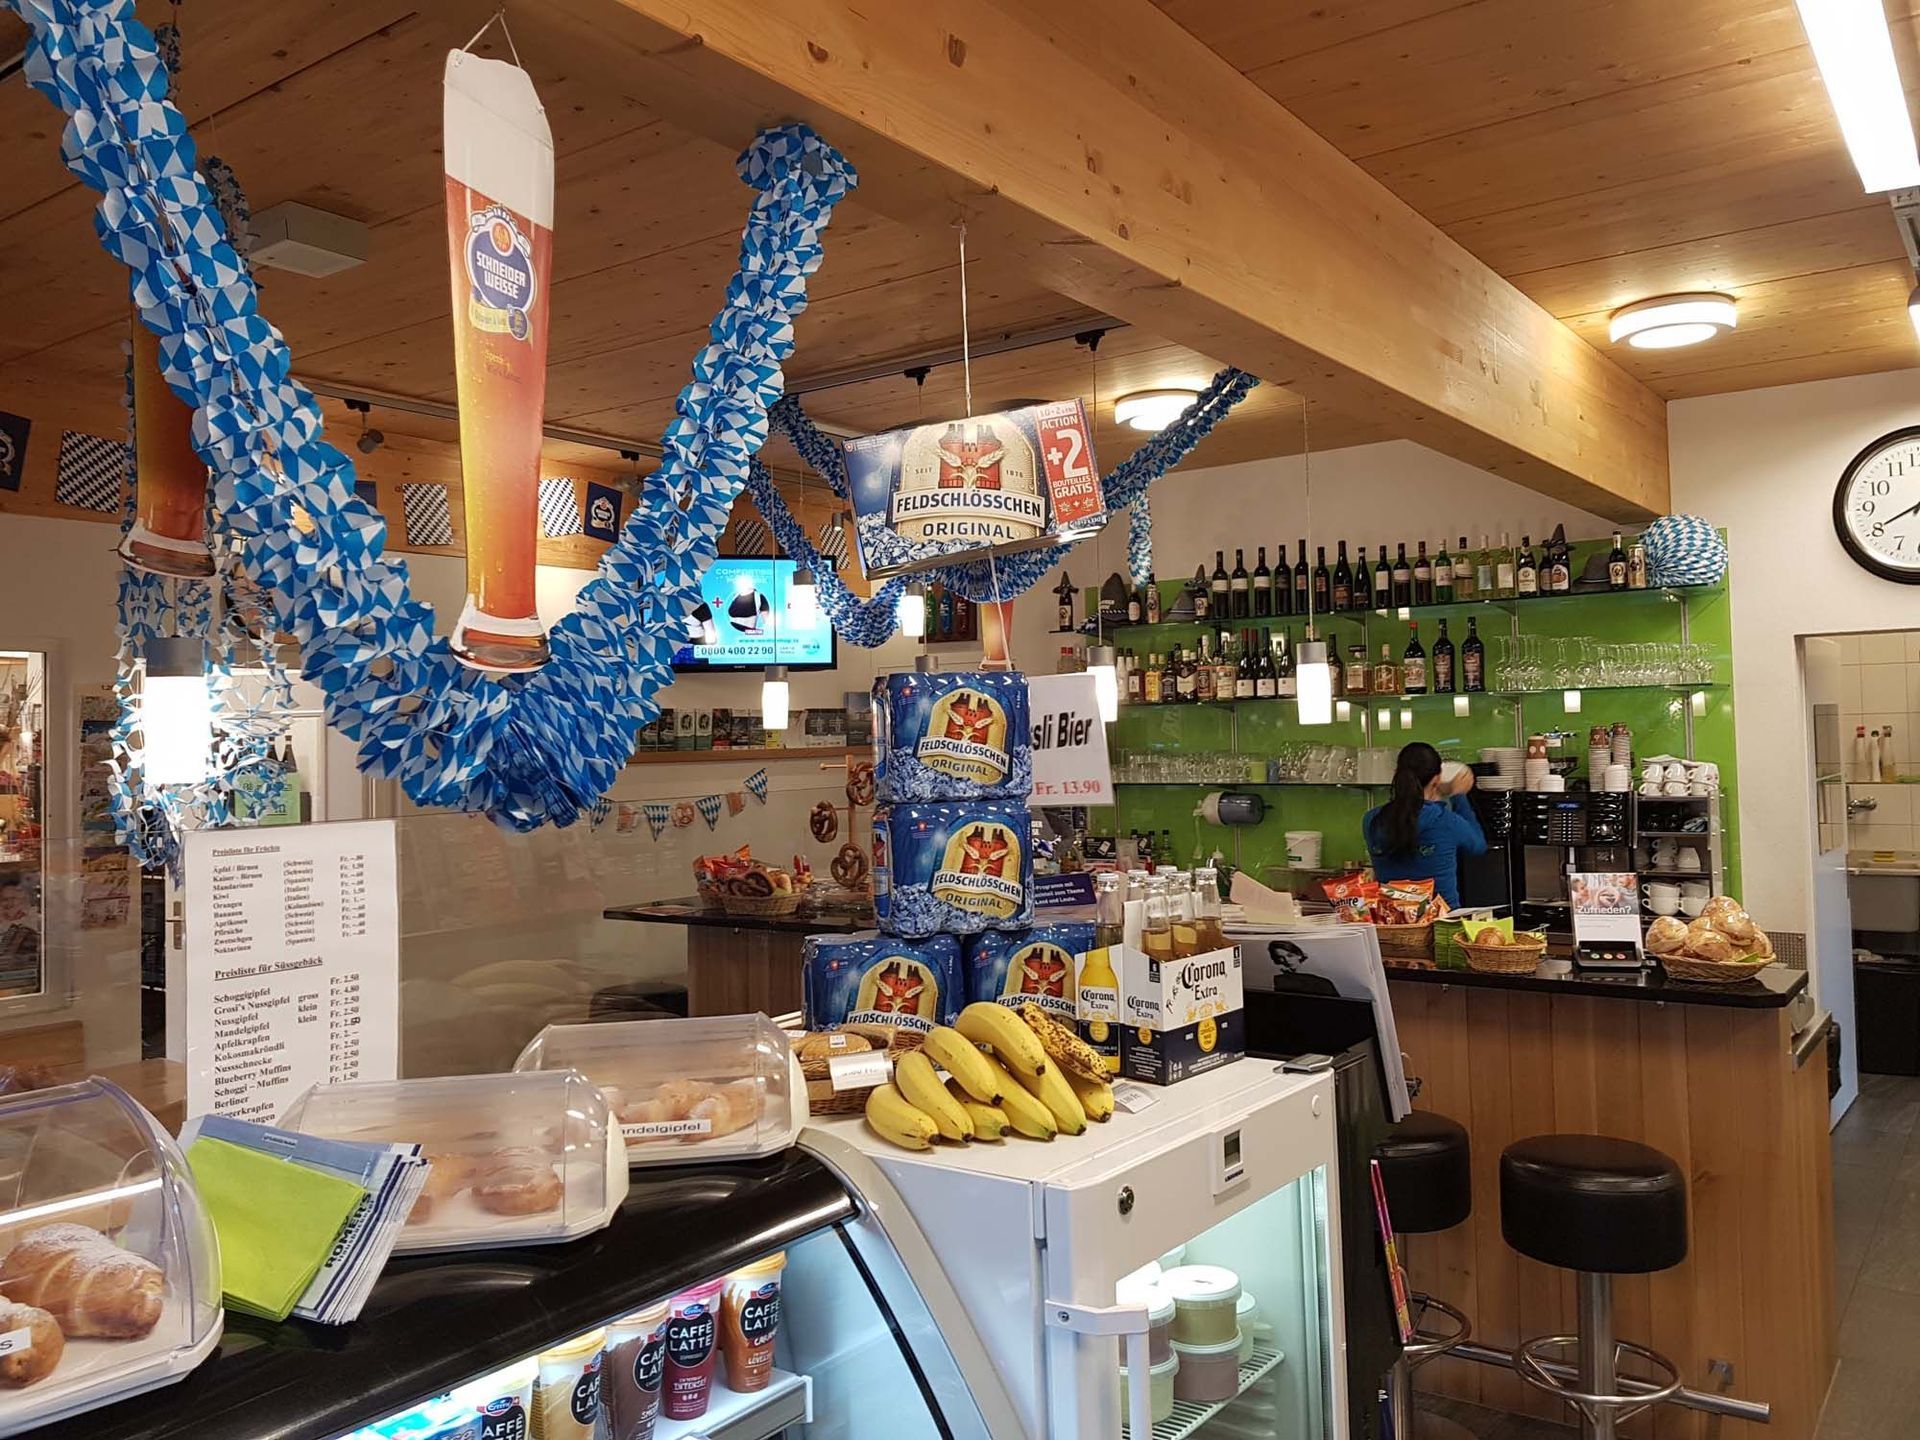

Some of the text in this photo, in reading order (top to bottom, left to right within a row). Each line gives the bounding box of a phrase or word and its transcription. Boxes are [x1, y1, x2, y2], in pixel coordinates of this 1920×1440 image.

[476, 250, 526, 288] SCHNEIDER
[484, 272, 519, 300] WEISSE
[1041, 415, 1078, 430] ACTION
[1888, 461, 1904, 477] 11
[1909, 452, 1920, 467] 1
[1053, 475, 1091, 489] BOUTEILLES
[1054, 482, 1094, 499] GRATIS
[1870, 480, 1890, 496] 10
[896, 489, 1041, 518] FELDSCHLÖSSCHEN
[1862, 500, 1875, 517] 9
[923, 522, 1015, 540] ORIGINAL
[1871, 522, 1885, 538] 8
[1893, 535, 1905, 551] 7
[728, 646, 746, 655] 400
[748, 646, 759, 655] 22
[1031, 711, 1093, 750] sli Bier
[920, 740, 1007, 769] FELDSCHLÖSSCHEN
[932, 758, 989, 777] ORIGINAL
[1035, 780, 1101, 796] Fr. 13.90
[934, 873, 1022, 900] FELDSCHLÖSSCHEN
[945, 893, 1004, 910] ORIGINAL
[1577, 904, 1632, 915] Zufrieden?
[214, 956, 323, 980] Preisliste für Süssgebäck
[1181, 960, 1228, 990] Corona
[213, 987, 271, 1004] Schoggigipfel
[330, 975, 342, 985] Fr.
[247, 995, 290, 1010] Nussgipfel
[297, 992, 319, 1003] gross
[330, 987, 342, 996] Fr.
[1081, 988, 1115, 1002] Corona
[1194, 984, 1219, 1001] Extra
[214, 1012, 259, 1028] Nussgipfel
[297, 1002, 318, 1013] klein
[330, 998, 342, 1008] Fr.
[998, 994, 1076, 1018] FELDSCHLÖSSCHE
[1090, 1001, 1109, 1010] Extra
[1127, 995, 1160, 1013] Corona
[214, 1022, 270, 1039] Mandelgipfel
[297, 1014, 318, 1024] klein
[330, 1009, 342, 1018] Fr.
[849, 1012, 934, 1033] FELDSCHLÖSSCHE
[1136, 1010, 1154, 1020] Extra
[214, 1034, 270, 1051] Apfelkrapfen
[330, 1020, 342, 1029] Fr.
[214, 1042, 285, 1063] Kokosmakröndli
[330, 1031, 342, 1040] Fr.
[214, 1056, 273, 1074] Nussschnecke
[330, 1042, 342, 1052] Fr.
[214, 1072, 257, 1086] Blueberry
[258, 1063, 292, 1077] Muffins
[330, 1053, 342, 1062] Fr.
[214, 1083, 248, 1098] Schoggi
[256, 1075, 289, 1089] Muffins
[329, 1064, 341, 1073] Fr.
[214, 1096, 250, 1110] Berliner
[329, 1075, 341, 1084] Fr.
[622, 1123, 700, 1136] ndelgipfel
[324, 1192, 372, 1268] ROMER'S
[669, 1319, 713, 1339] CAFFÈ
[744, 1311, 779, 1331] LATTE
[669, 1333, 712, 1352] LATTE
[640, 1343, 665, 1366] CAF
[639, 1359, 664, 1380] LAT
[576, 1377, 601, 1398] CAF
[576, 1391, 600, 1413] LAT
[482, 1412, 524, 1438] AFFÈ
